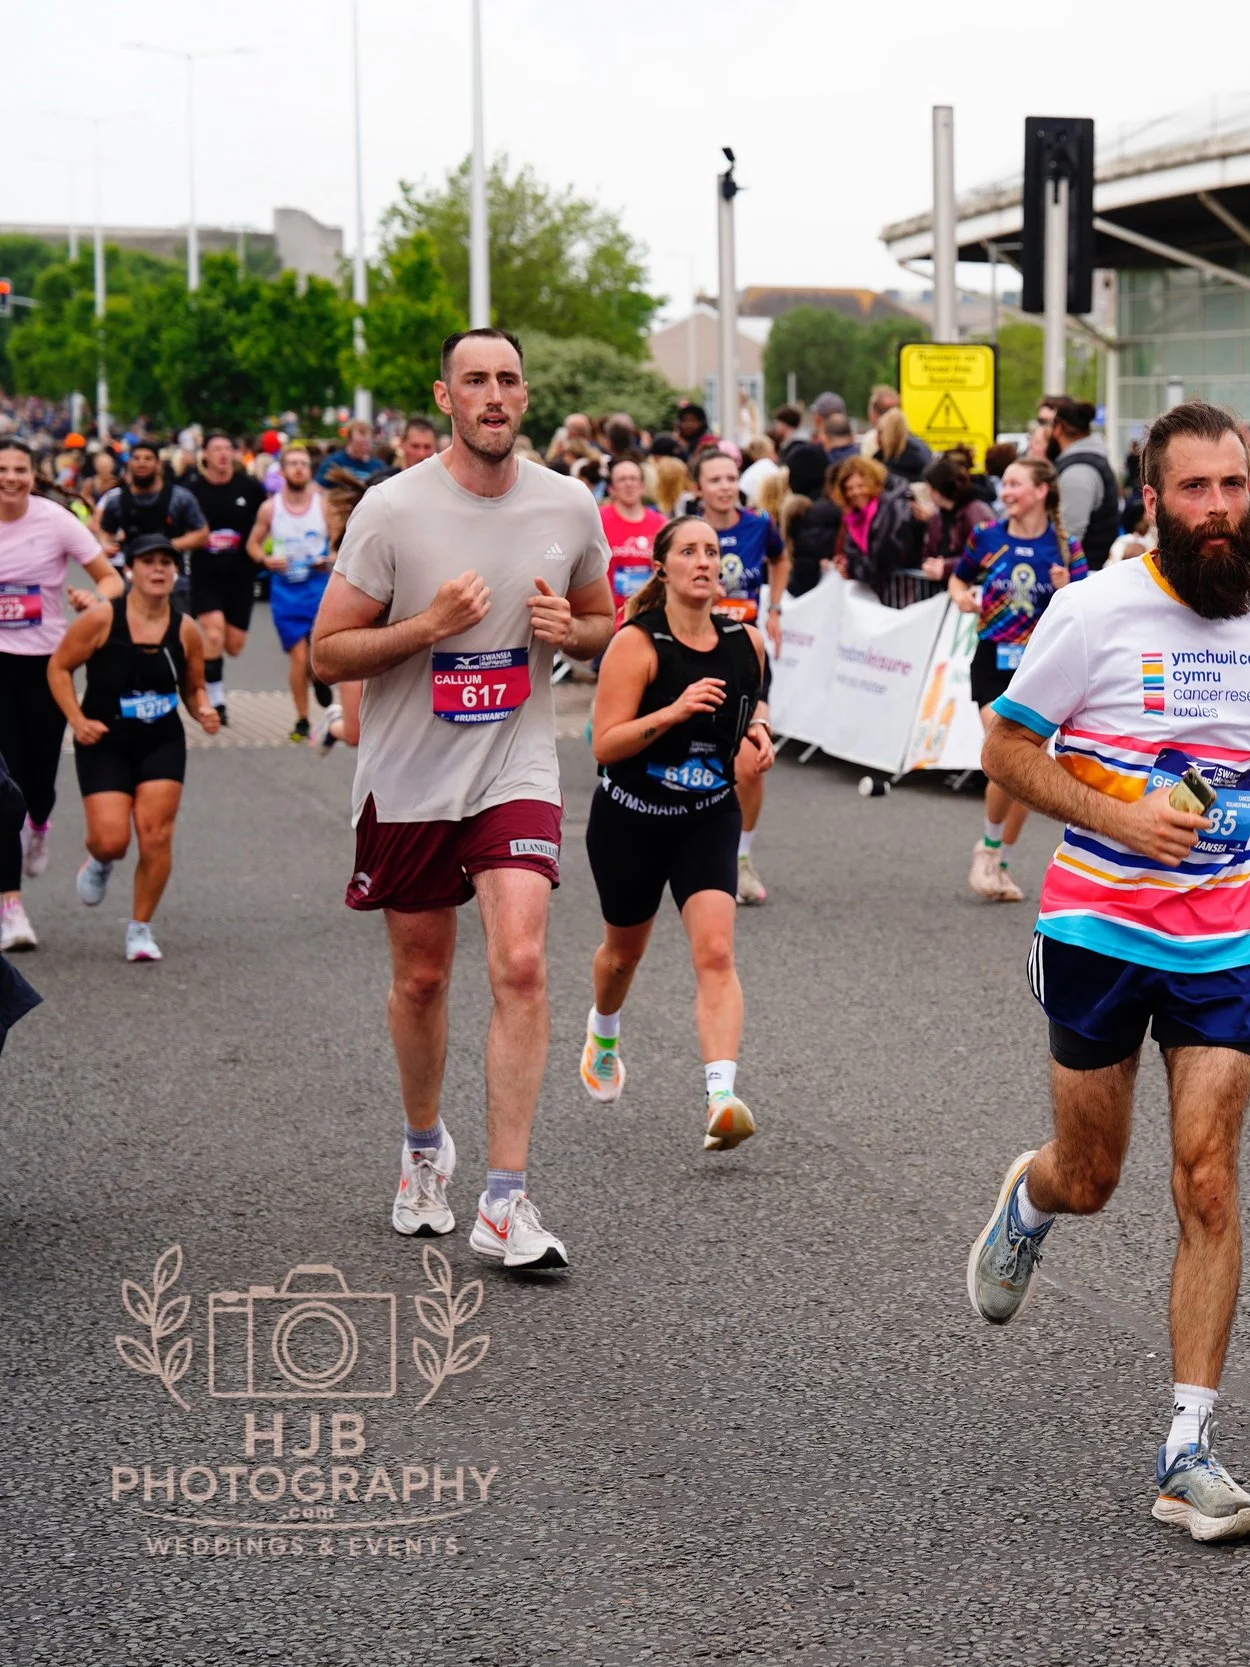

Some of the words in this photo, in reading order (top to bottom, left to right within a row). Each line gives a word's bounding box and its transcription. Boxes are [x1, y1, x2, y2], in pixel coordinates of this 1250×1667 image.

[1172, 650, 1237, 667] ymchwil
[434, 674, 482, 685] CALLUM
[1173, 670, 1221, 685] cymru
[462, 683, 507, 708] 617
[1173, 688, 1223, 701] cancer
[1173, 705, 1219, 718] wales
[1152, 775, 1181, 789] GE
